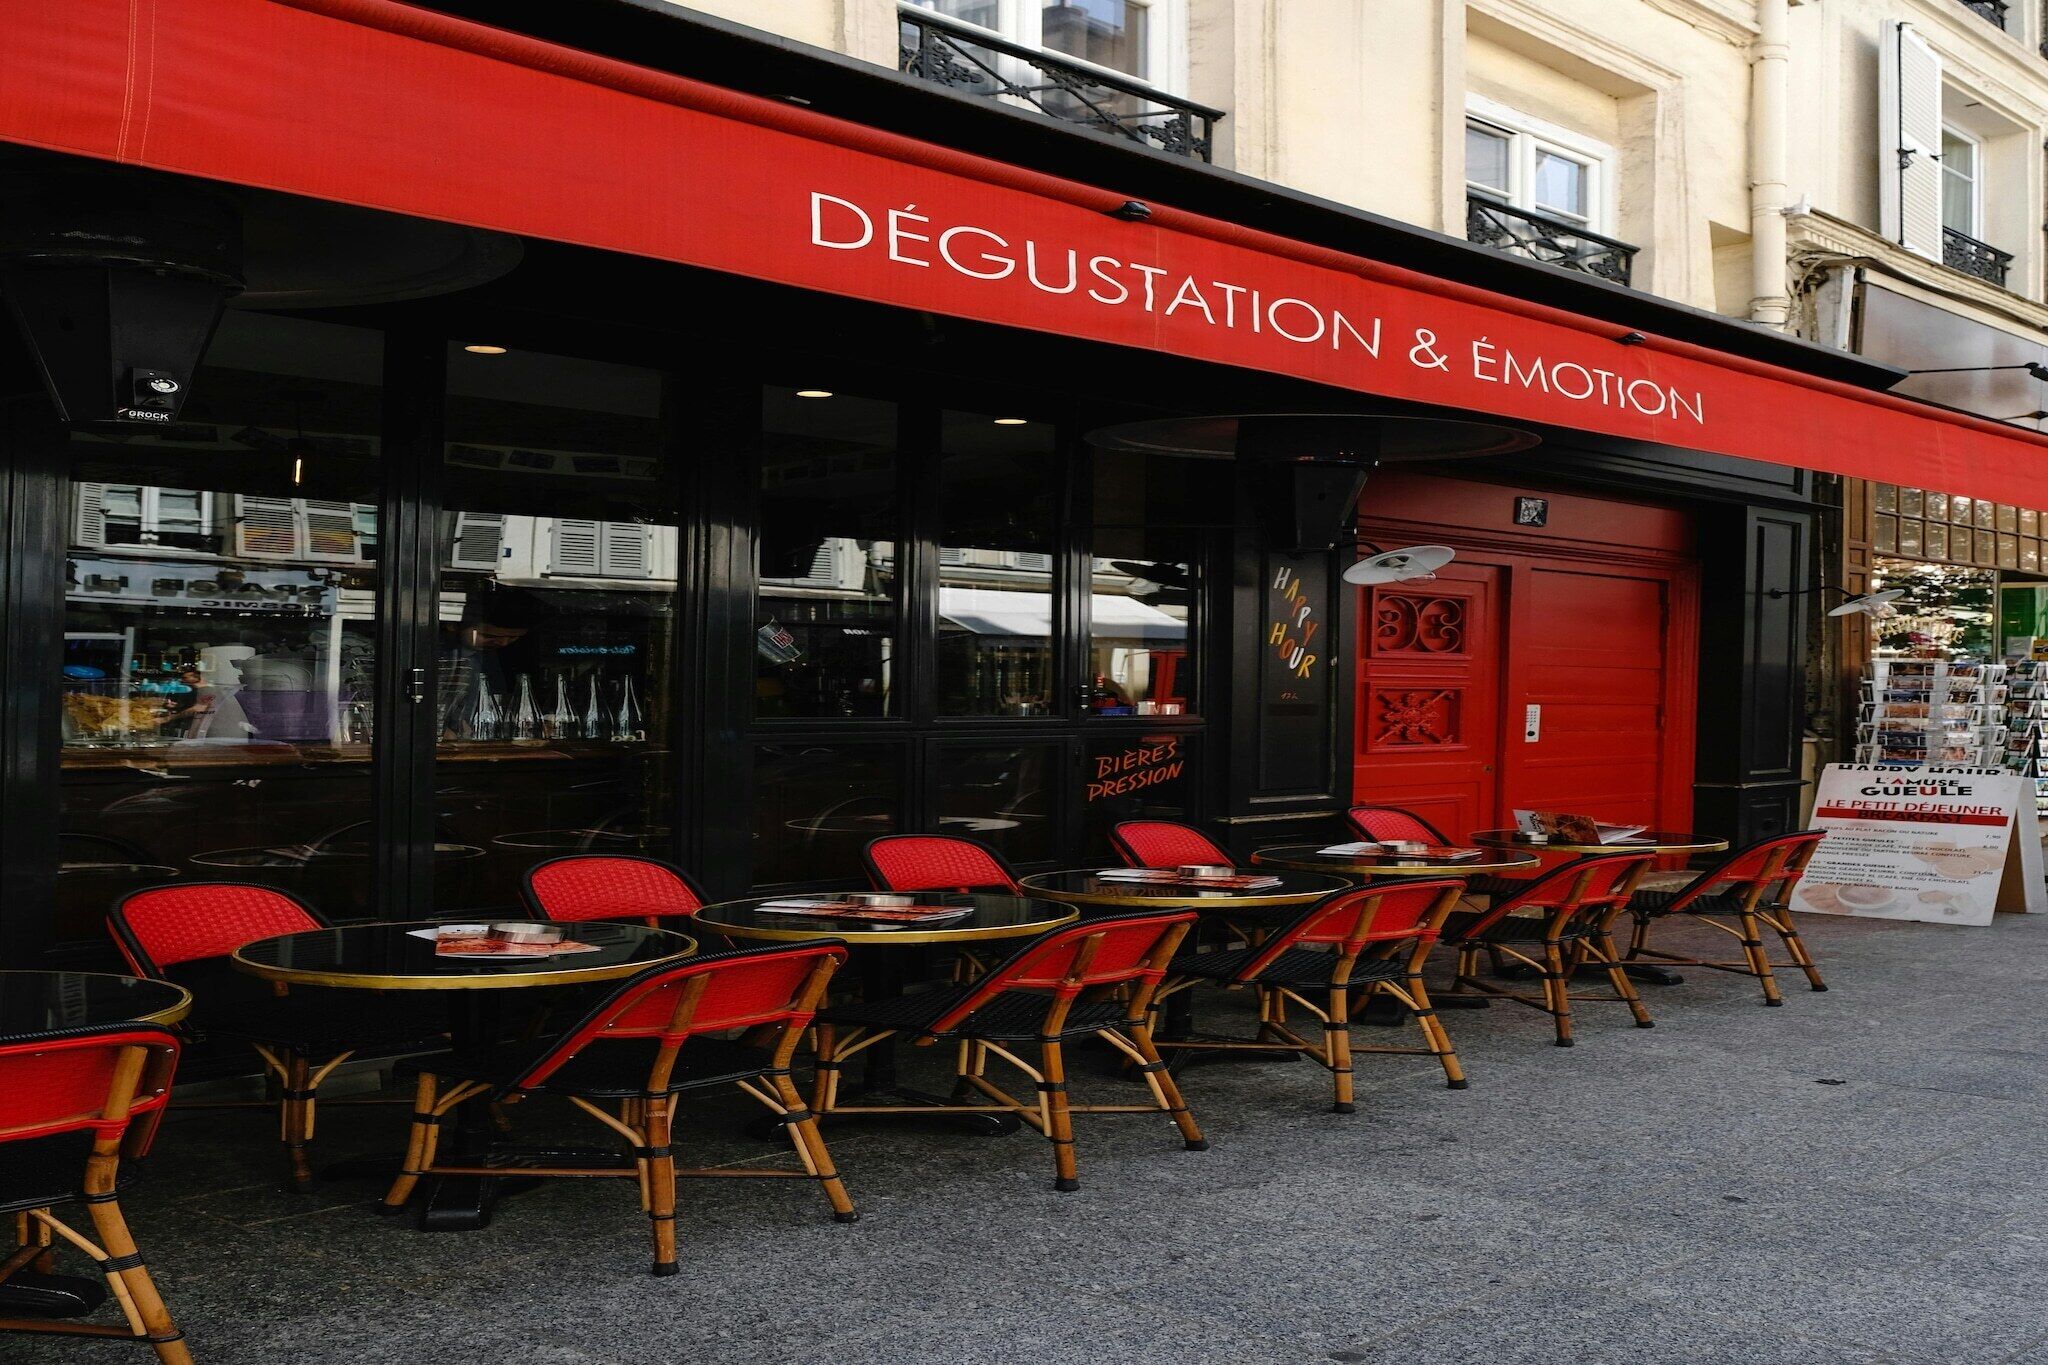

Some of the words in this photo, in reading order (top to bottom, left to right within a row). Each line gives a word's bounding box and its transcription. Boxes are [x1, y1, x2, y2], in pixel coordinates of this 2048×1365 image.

[811, 191, 1382, 359] DÉGUSTATION
[1409, 328, 1449, 372] &
[1472, 336, 1704, 425] ÉMOTION
[128, 410, 169, 420] GROCK
[1273, 566, 1319, 647] HAPPY
[1269, 622, 1317, 679] HOUR
[1095, 741, 1177, 779] BIÈRES
[1087, 760, 1184, 801] PRESSION
[1860, 786, 1973, 796] GUEULE
[1875, 777, 1960, 787] L'AMUSE
[1826, 799, 1846, 809] LE
[1850, 800, 1900, 811] PETIT
[1904, 801, 2003, 815] DÉJEUNER
[1857, 810, 1965, 824] BREAKFAST
